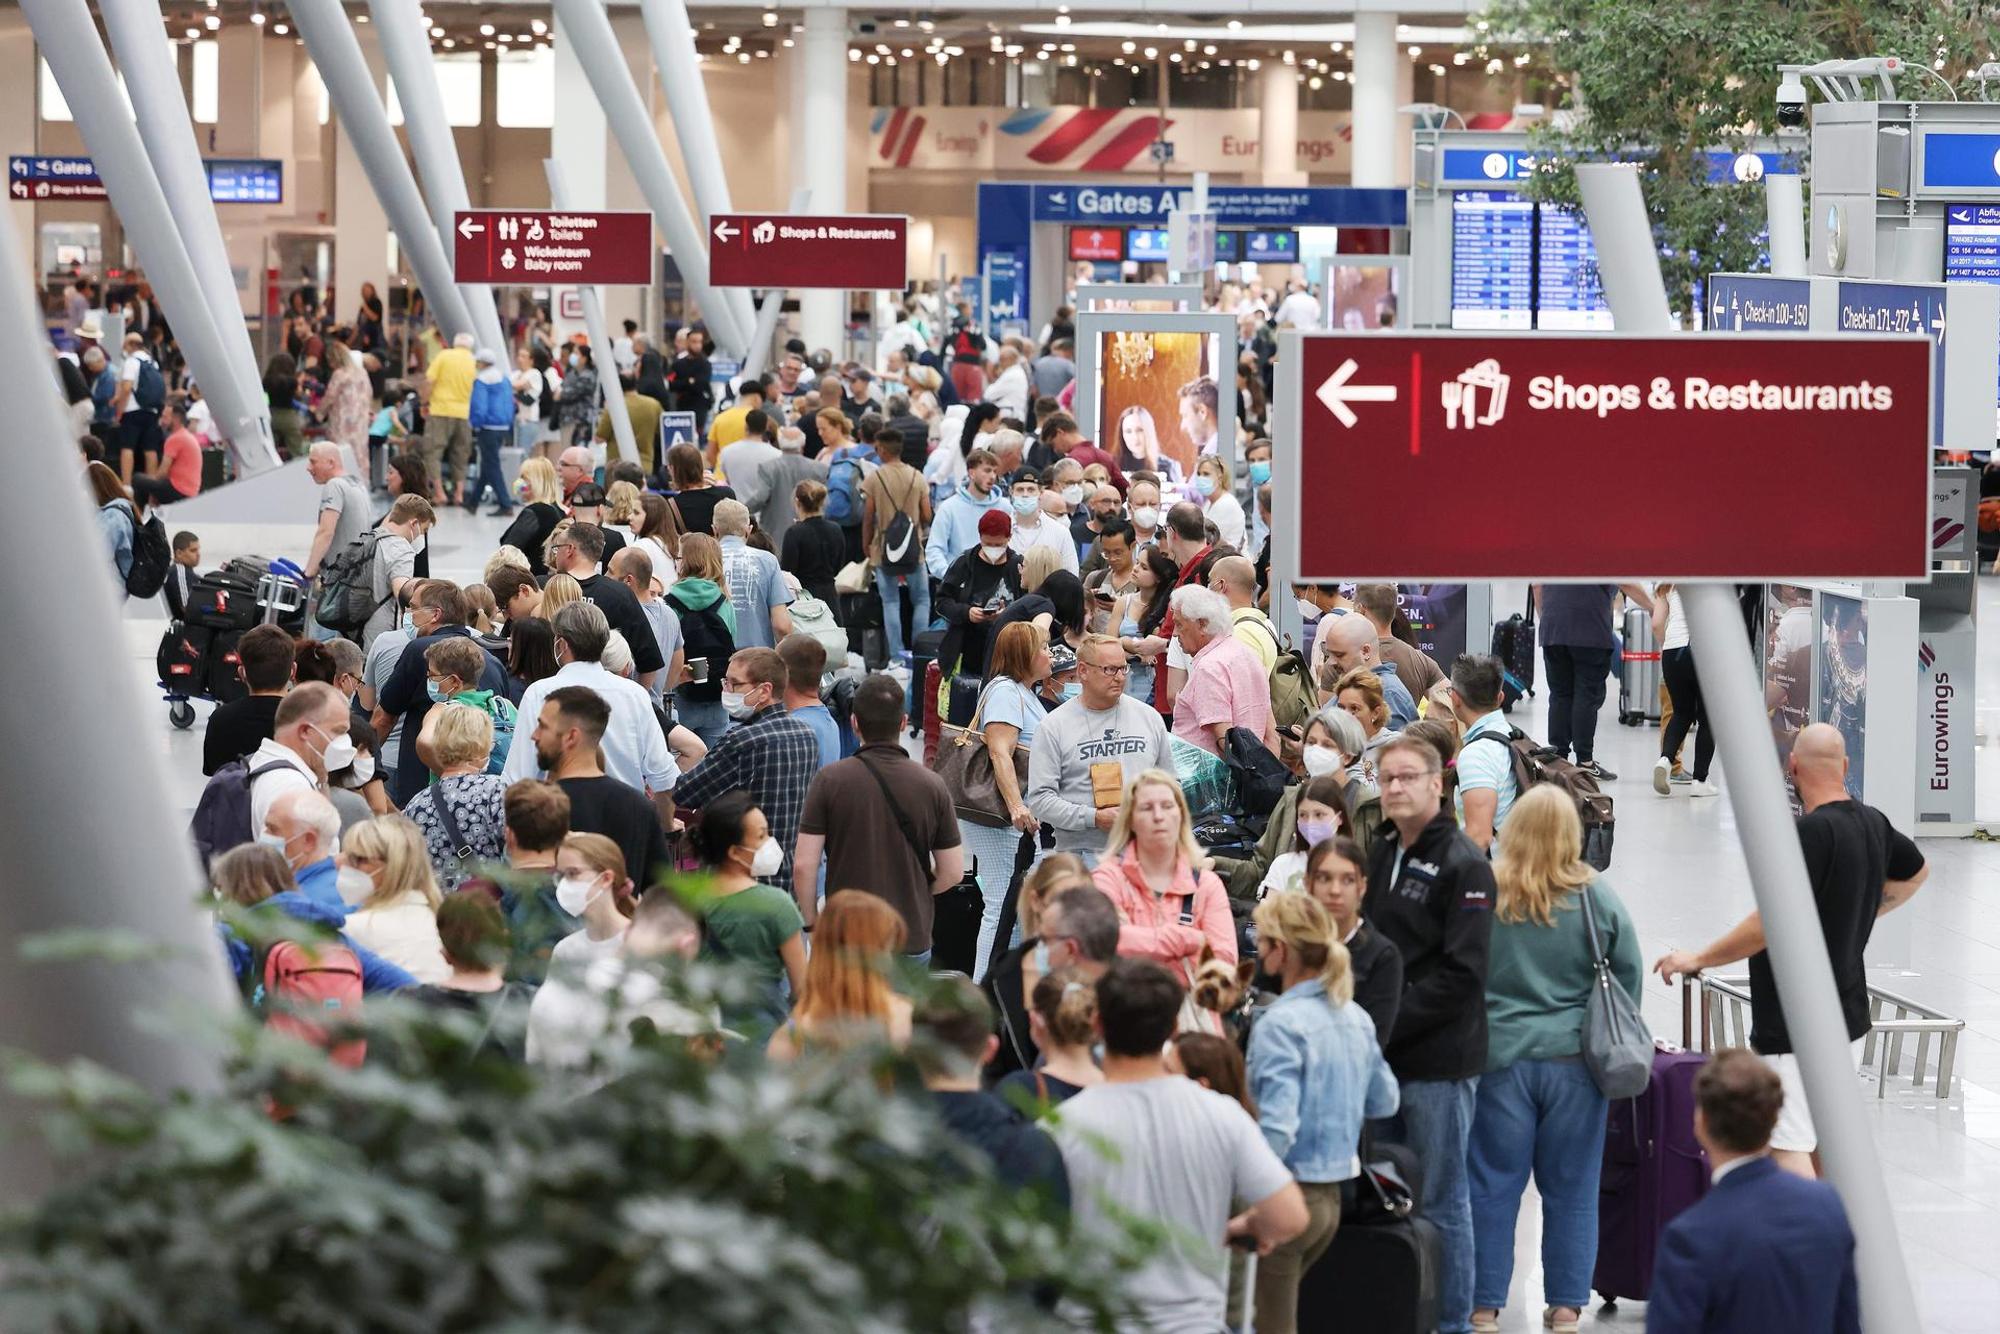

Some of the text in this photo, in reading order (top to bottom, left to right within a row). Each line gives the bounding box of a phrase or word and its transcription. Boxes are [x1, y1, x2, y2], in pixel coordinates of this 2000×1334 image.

[51, 160, 93, 175] Gates
[1077, 189, 1176, 214] Gates A
[548, 215, 598, 229] Toiletten
[549, 228, 583, 241] Toilets
[779, 226, 897, 240] Shops & Restaurants
[524, 245, 591, 258] Wickelraum
[524, 258, 583, 273] Baby room
[1744, 300, 1775, 323] Check-in
[1843, 305, 1876, 330] Check-in
[1527, 375, 1894, 418] Shops & Restaurants
[664, 417, 691, 427] Gates
[1930, 672, 1954, 790] Eurowings
[1079, 740, 1147, 761] STARTER
